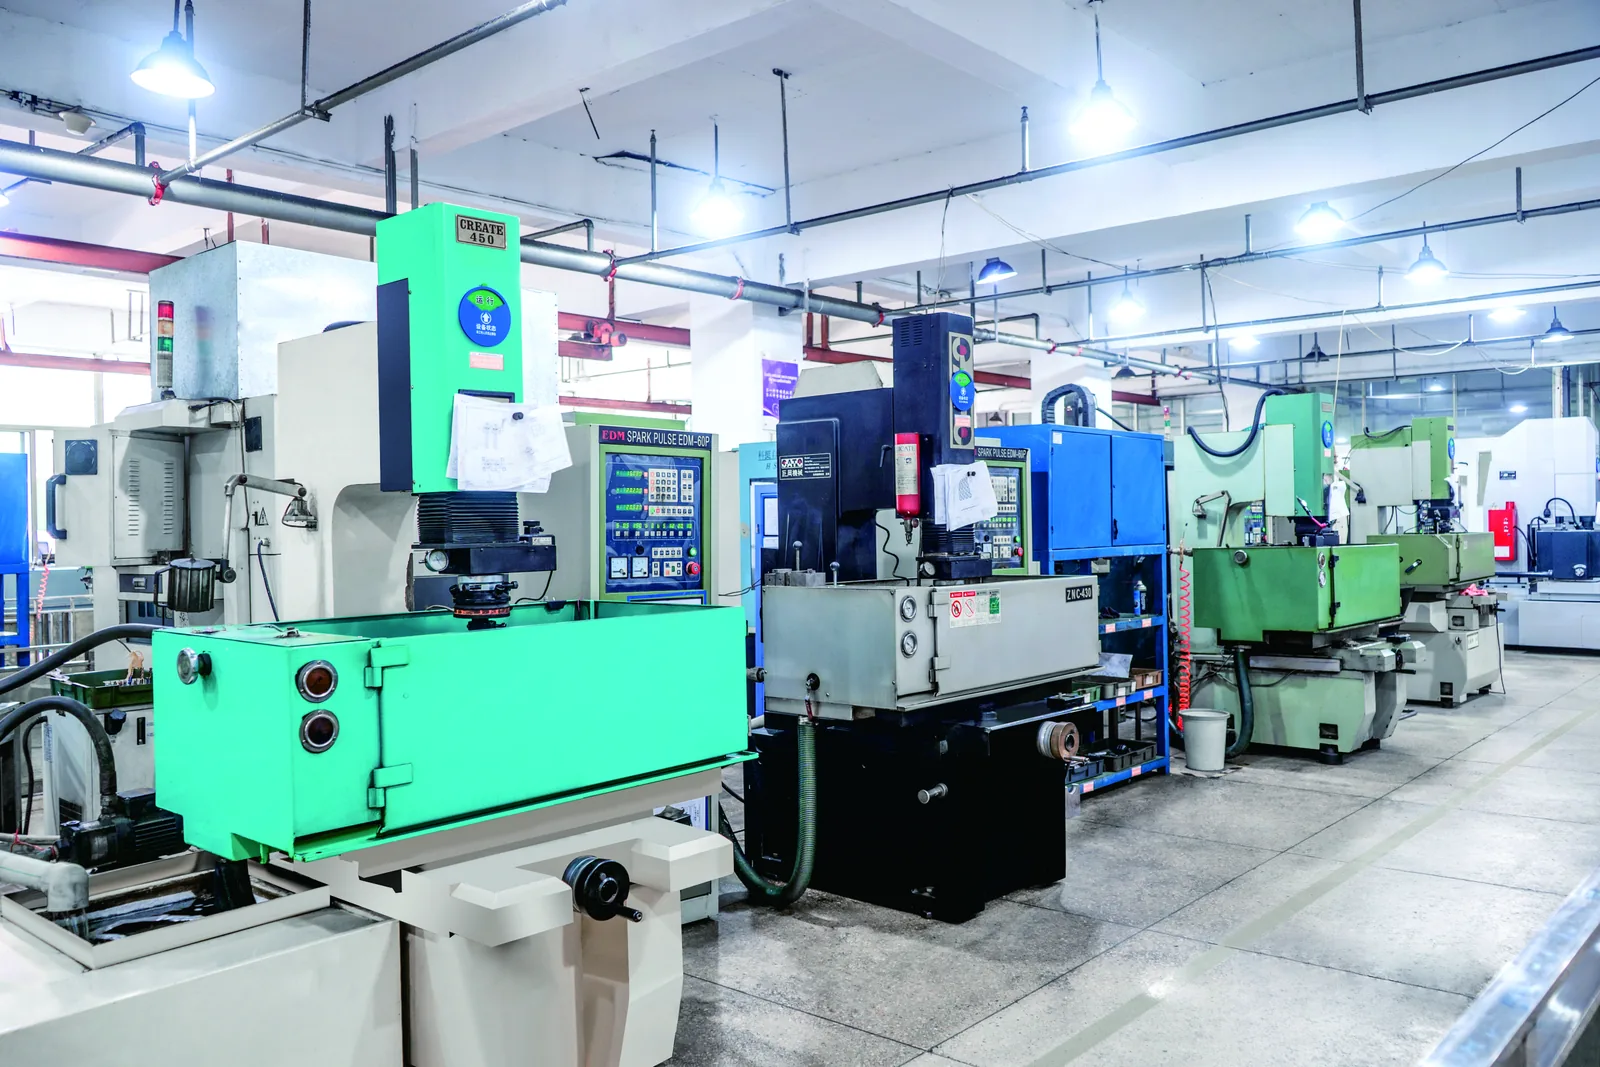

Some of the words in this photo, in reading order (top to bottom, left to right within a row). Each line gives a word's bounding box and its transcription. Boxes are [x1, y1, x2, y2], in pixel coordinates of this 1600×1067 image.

[460, 219, 503, 235] CREATE
[470, 233, 494, 245] 450
[602, 430, 625, 440] EDM
[627, 431, 651, 443] SPARK
[654, 433, 677, 445] PULSE
[679, 436, 709, 447] EDM-60P
[978, 448, 992, 456] SPARK
[993, 449, 1006, 457] PULSE
[1067, 587, 1092, 600] ZNC-430
